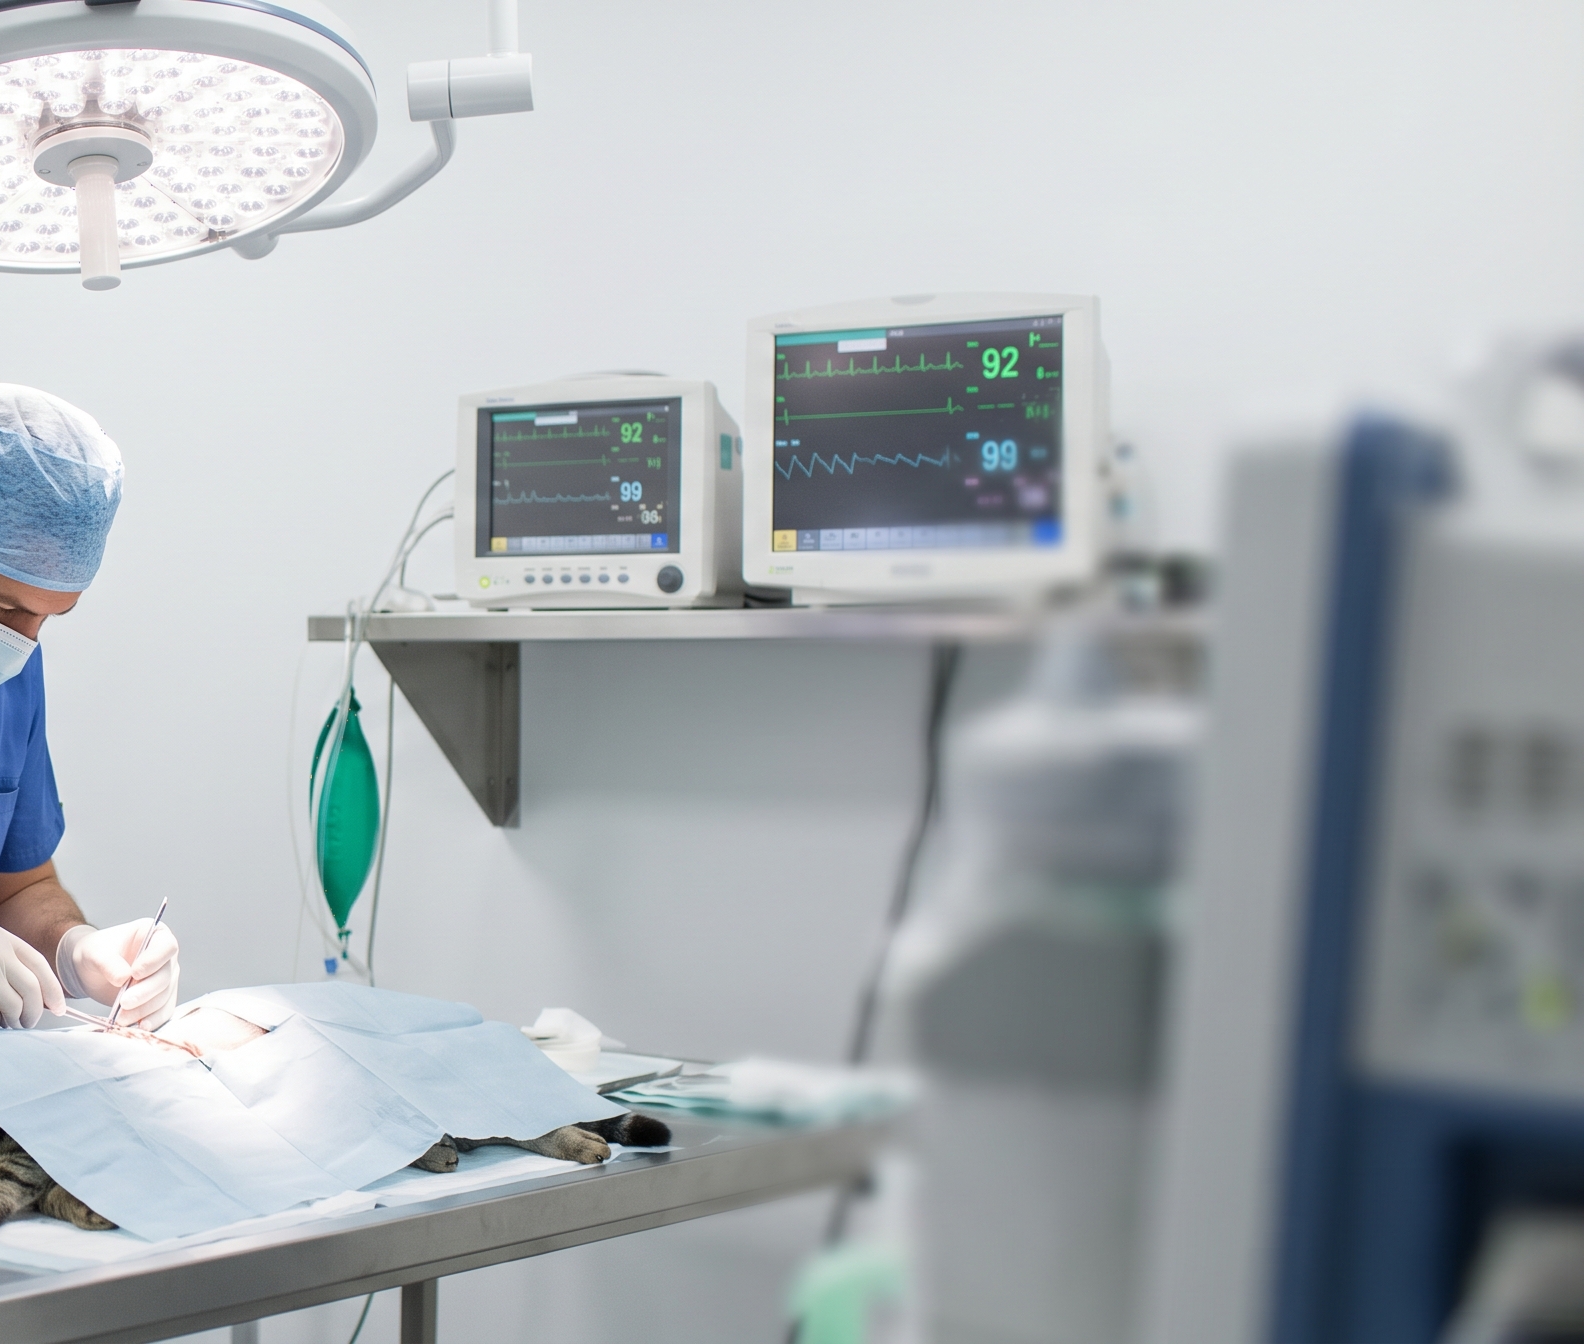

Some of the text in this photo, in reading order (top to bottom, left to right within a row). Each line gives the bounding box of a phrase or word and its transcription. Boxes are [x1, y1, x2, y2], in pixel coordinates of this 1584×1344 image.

[982, 346, 1019, 379] 92
[621, 422, 643, 443] 92
[981, 439, 1017, 471] 99
[620, 481, 642, 502] 99
